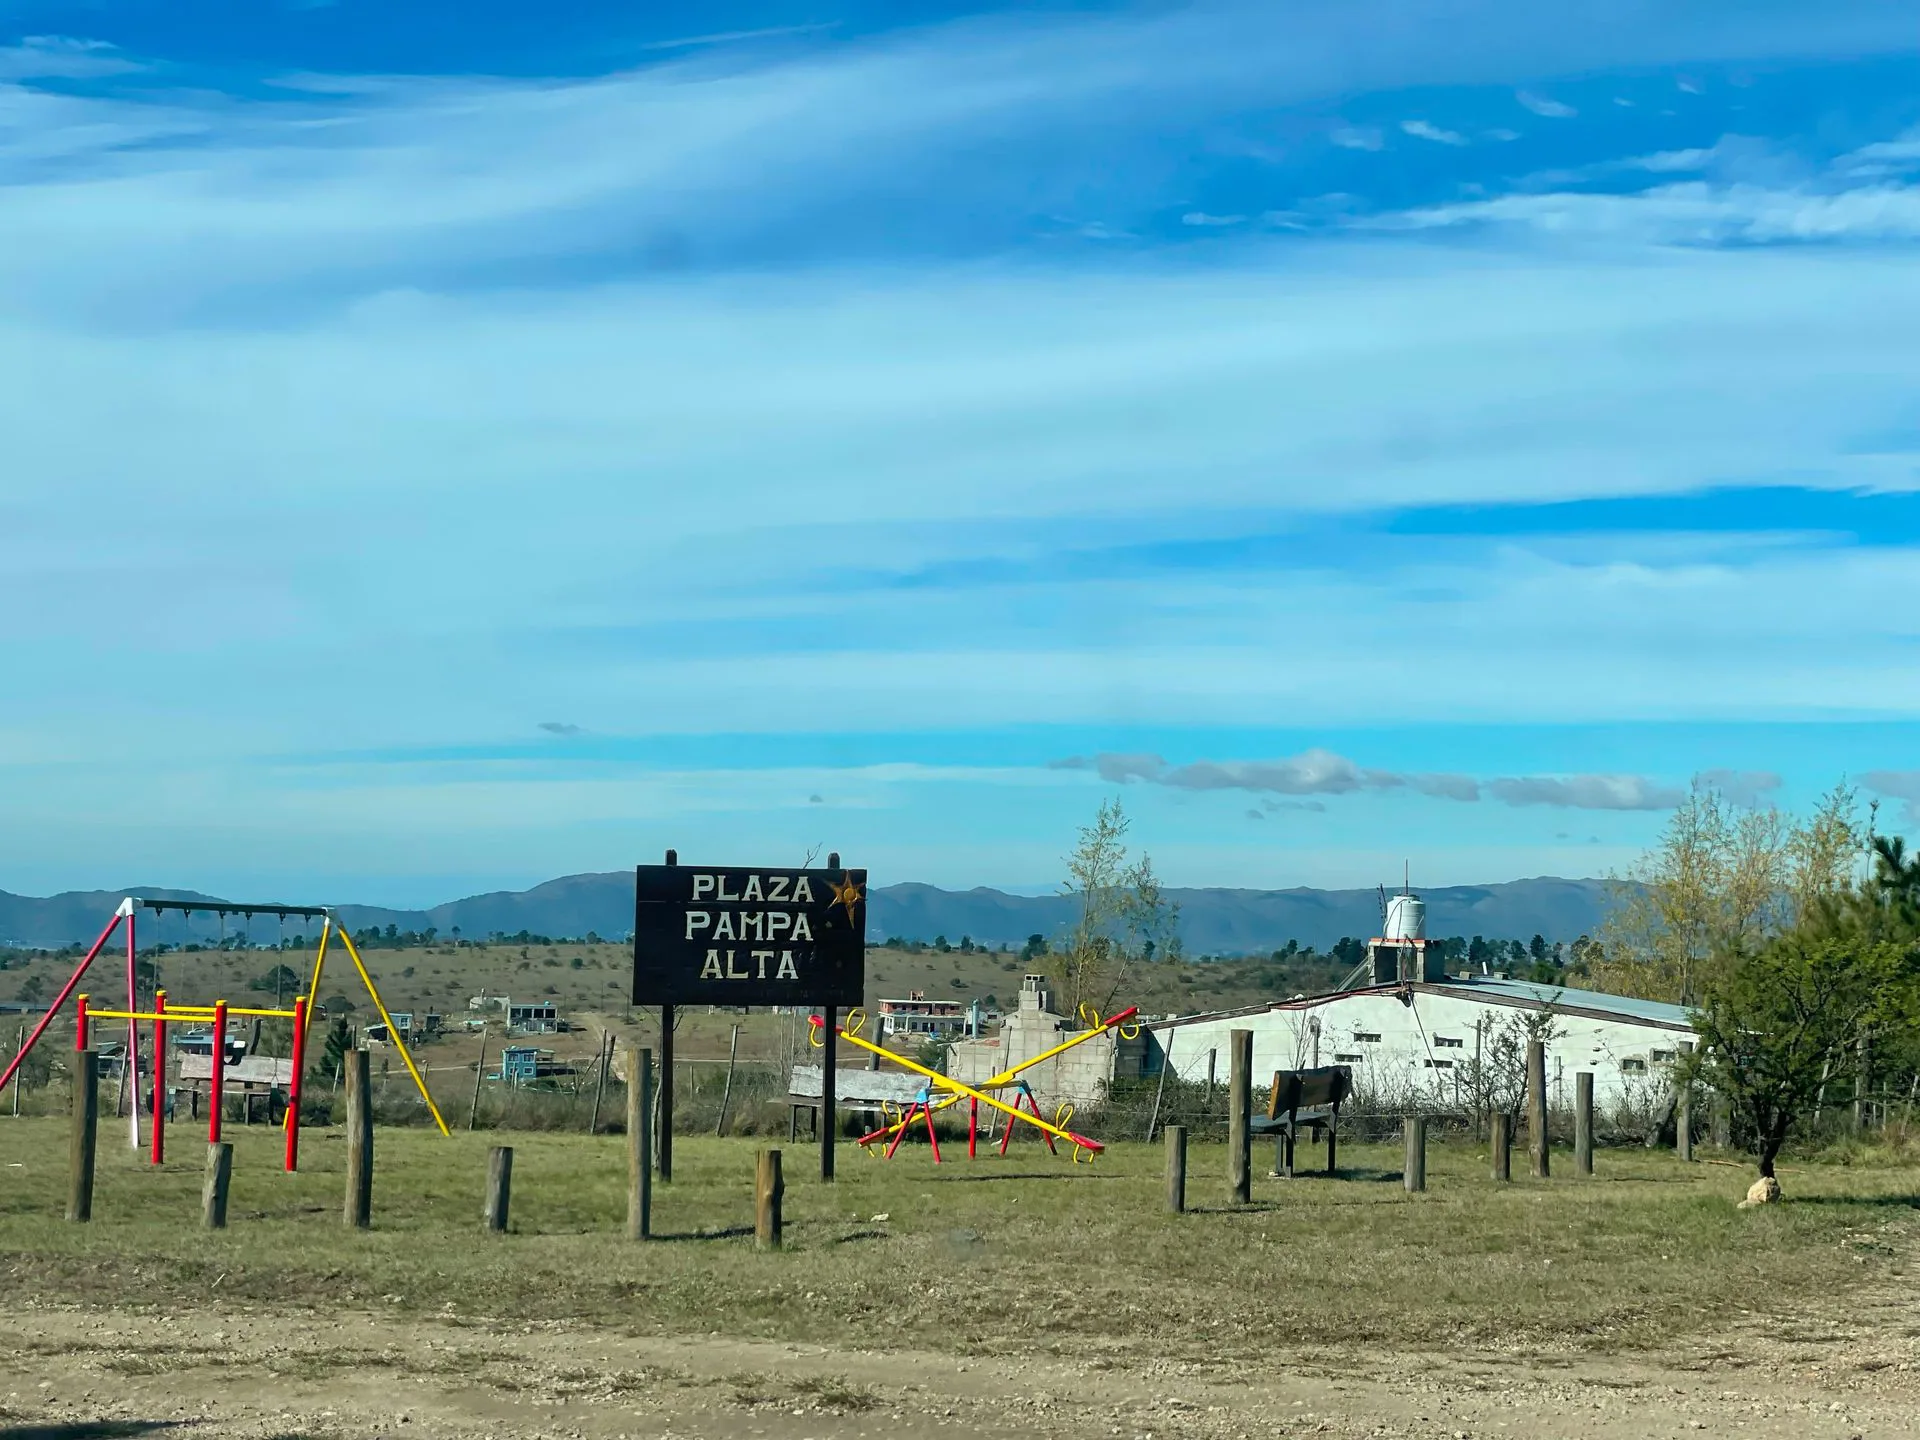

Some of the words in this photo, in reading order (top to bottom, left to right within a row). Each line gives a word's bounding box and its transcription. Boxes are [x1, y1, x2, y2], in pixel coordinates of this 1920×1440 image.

[692, 874, 815, 903] PLAZA
[685, 911, 814, 941] PAMPA
[700, 949, 799, 980] ALTA
